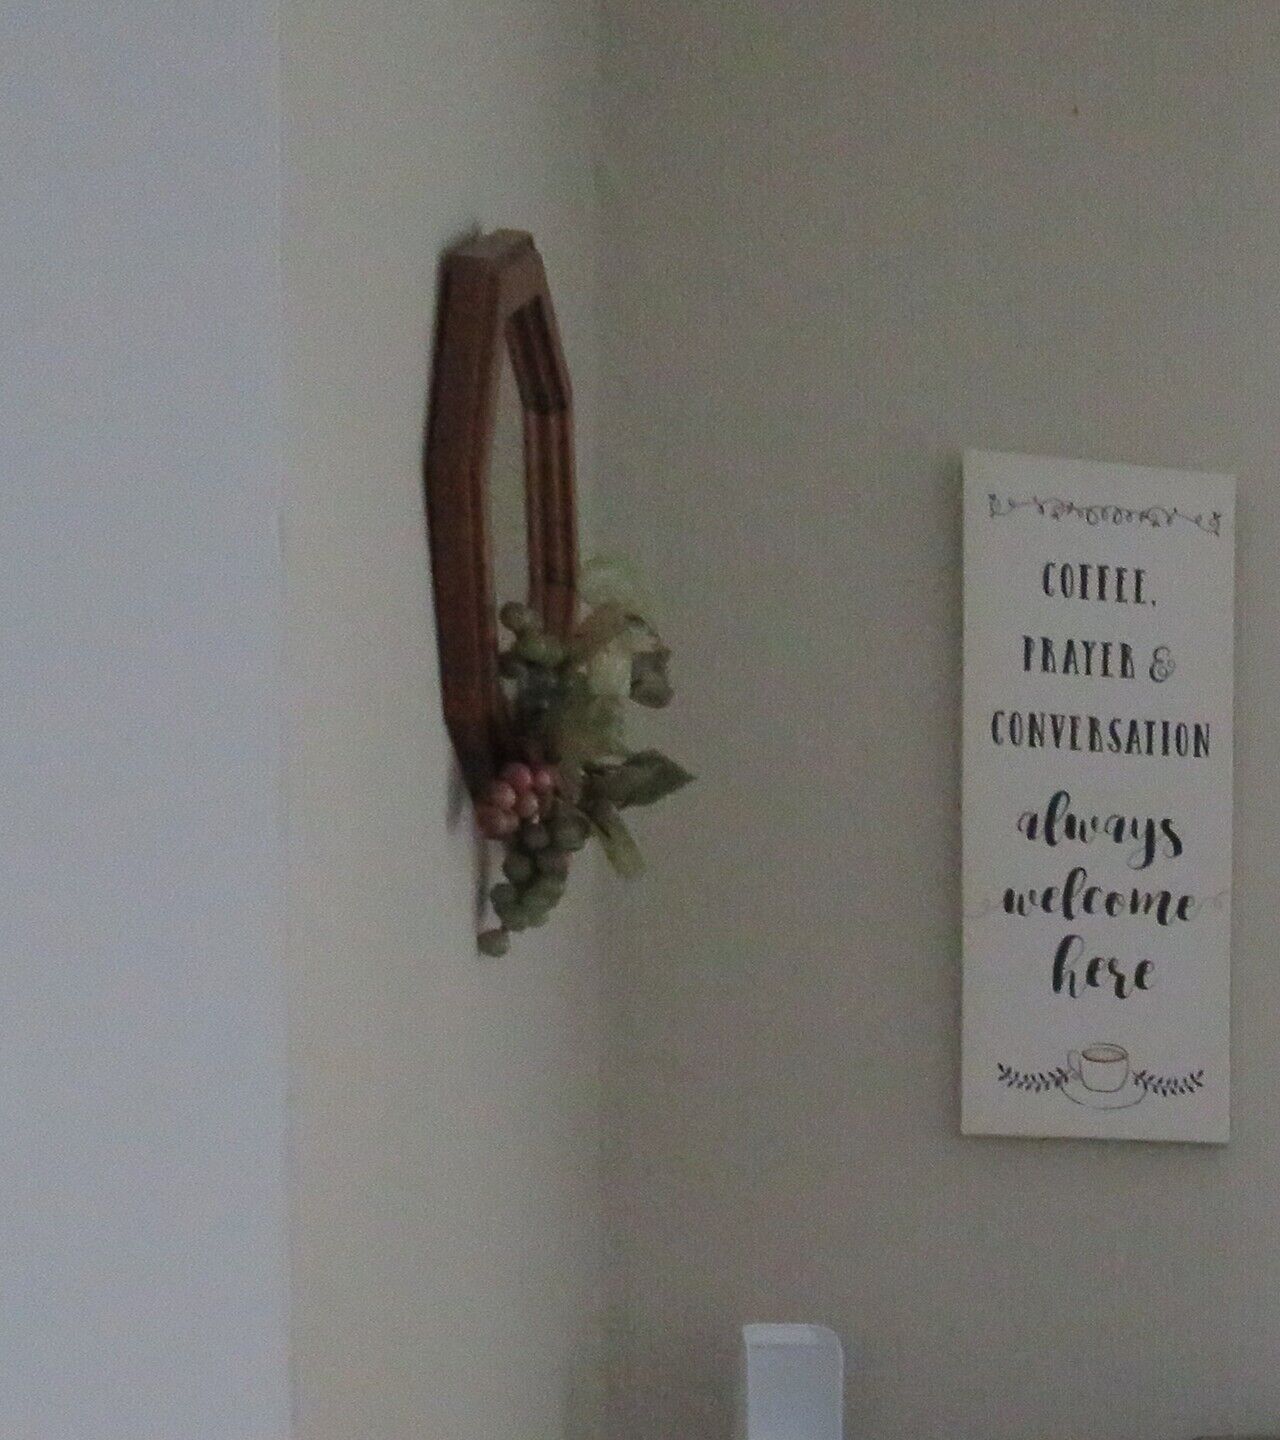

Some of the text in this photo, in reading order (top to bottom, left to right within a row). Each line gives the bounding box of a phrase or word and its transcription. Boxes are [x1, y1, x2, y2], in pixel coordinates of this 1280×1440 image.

[1022, 634, 1176, 683] PRAYER &
[991, 709, 1210, 758] CONVERSATION
[1017, 790, 1183, 870] always
[1003, 866, 1196, 926] welcome
[1052, 934, 1155, 999] here
